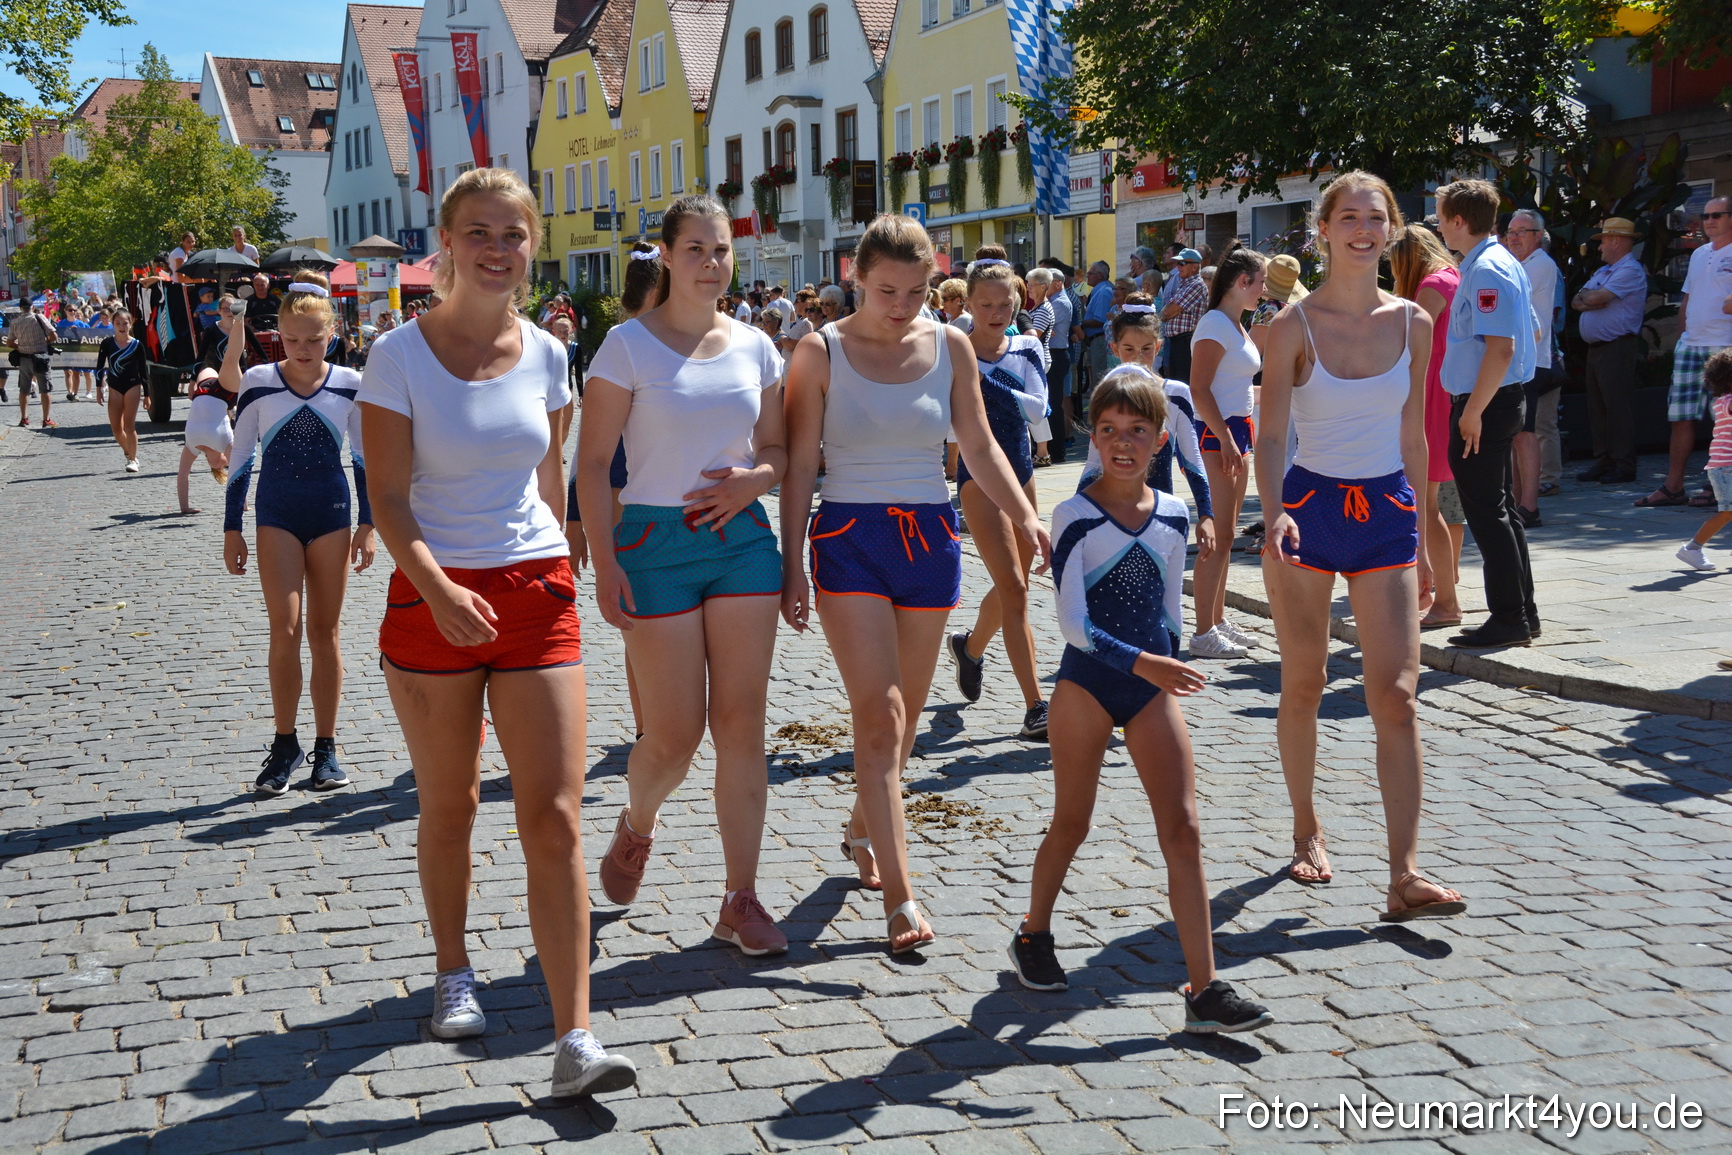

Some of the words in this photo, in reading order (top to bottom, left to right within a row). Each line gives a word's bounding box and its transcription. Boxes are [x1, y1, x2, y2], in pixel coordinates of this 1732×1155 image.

[455, 36, 471, 72] K&L
[569, 138, 589, 157] HOTEL
[1080, 177, 1092, 189] KINO
[1103, 153, 1111, 208] KINO
[646, 213, 664, 226] AIFUN
[570, 233, 598, 246] Restaurant
